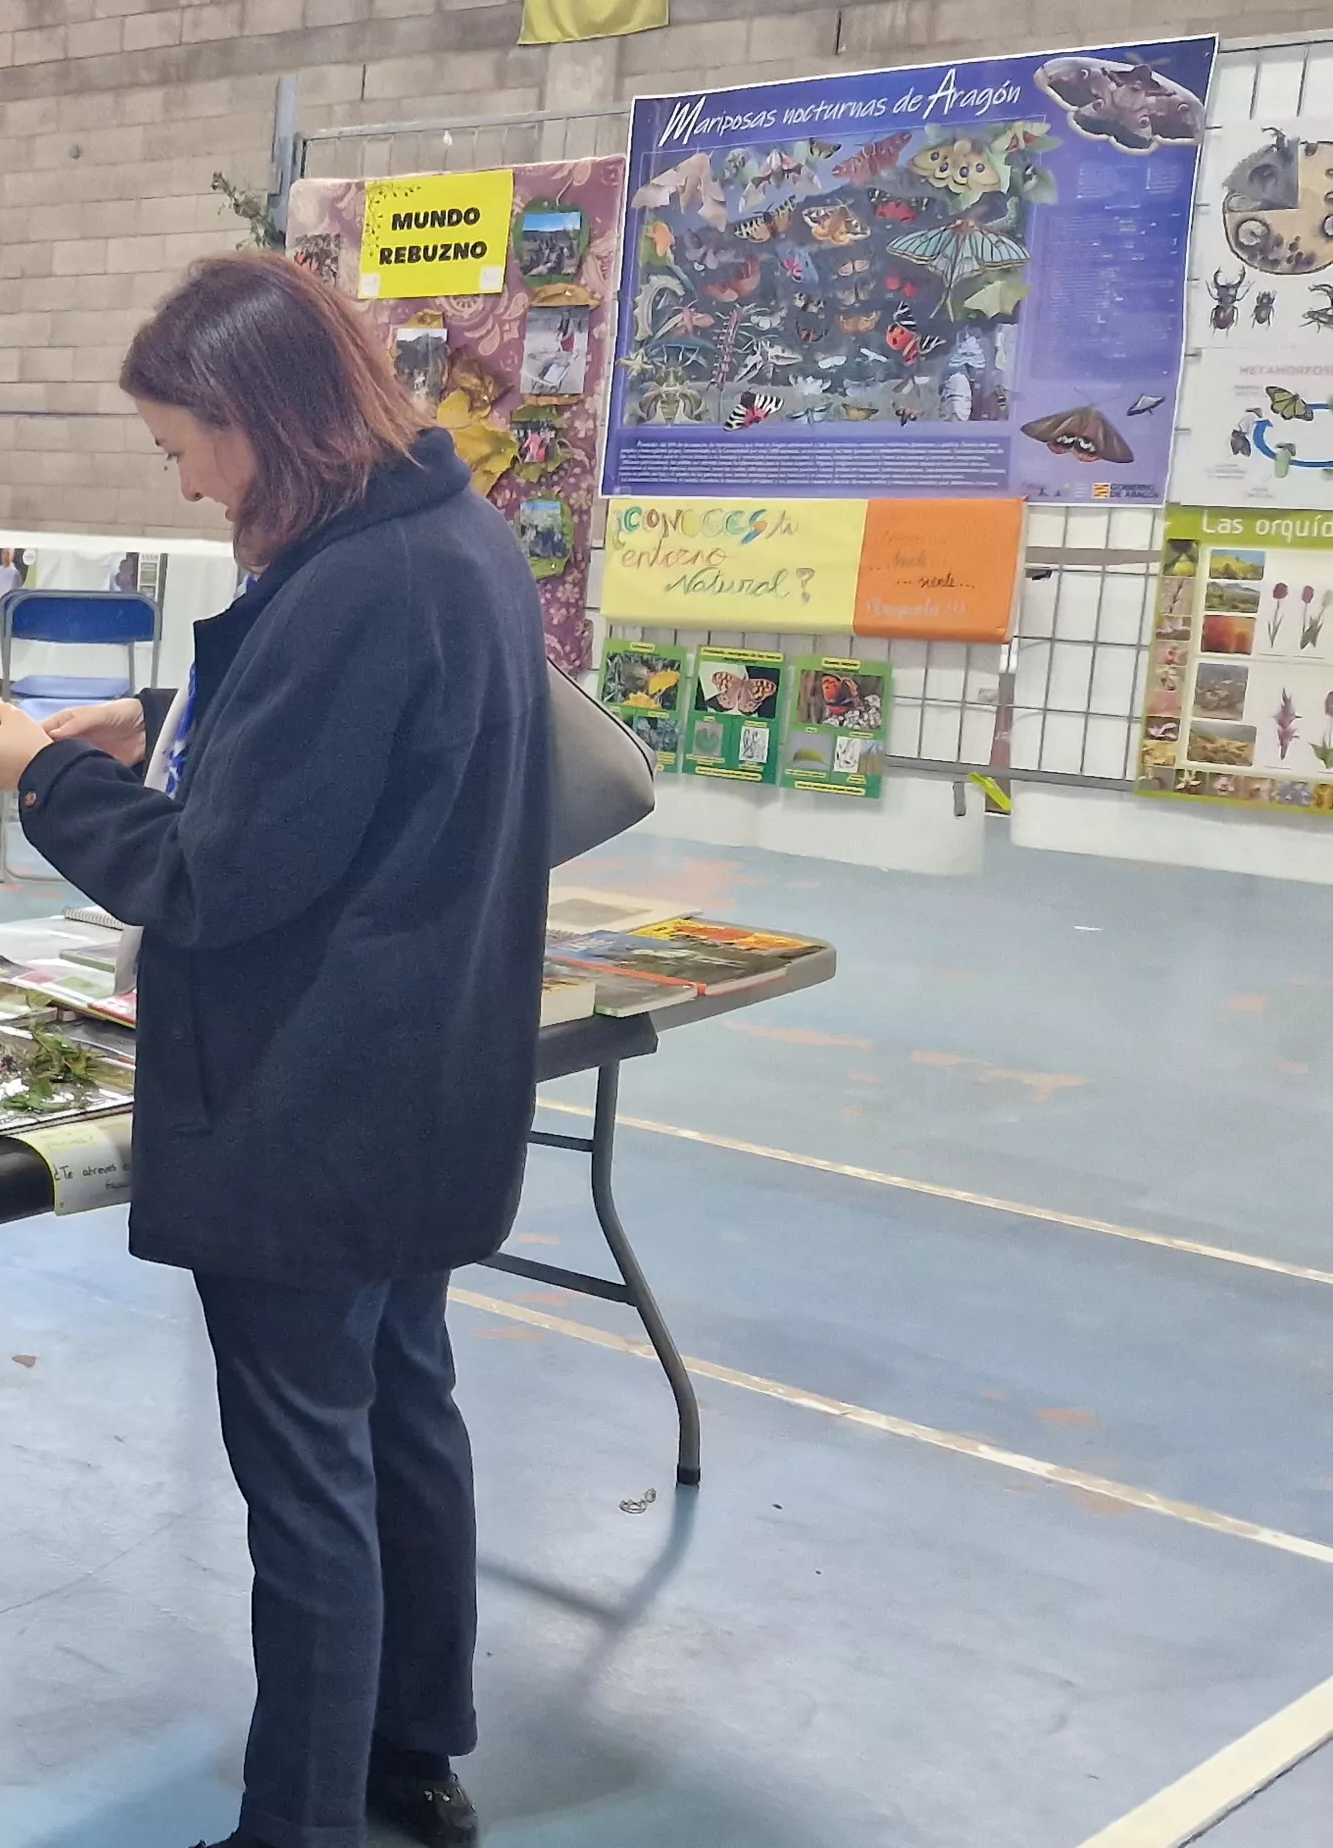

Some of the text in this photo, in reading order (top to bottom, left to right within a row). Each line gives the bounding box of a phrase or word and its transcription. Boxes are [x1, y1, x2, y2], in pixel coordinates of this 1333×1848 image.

[659, 68, 1020, 147] Mariposas nocturnas de Aragón
[391, 207, 481, 231] MUNDO
[379, 240, 488, 266] REBUZNO
[1202, 509, 1244, 535] Las
